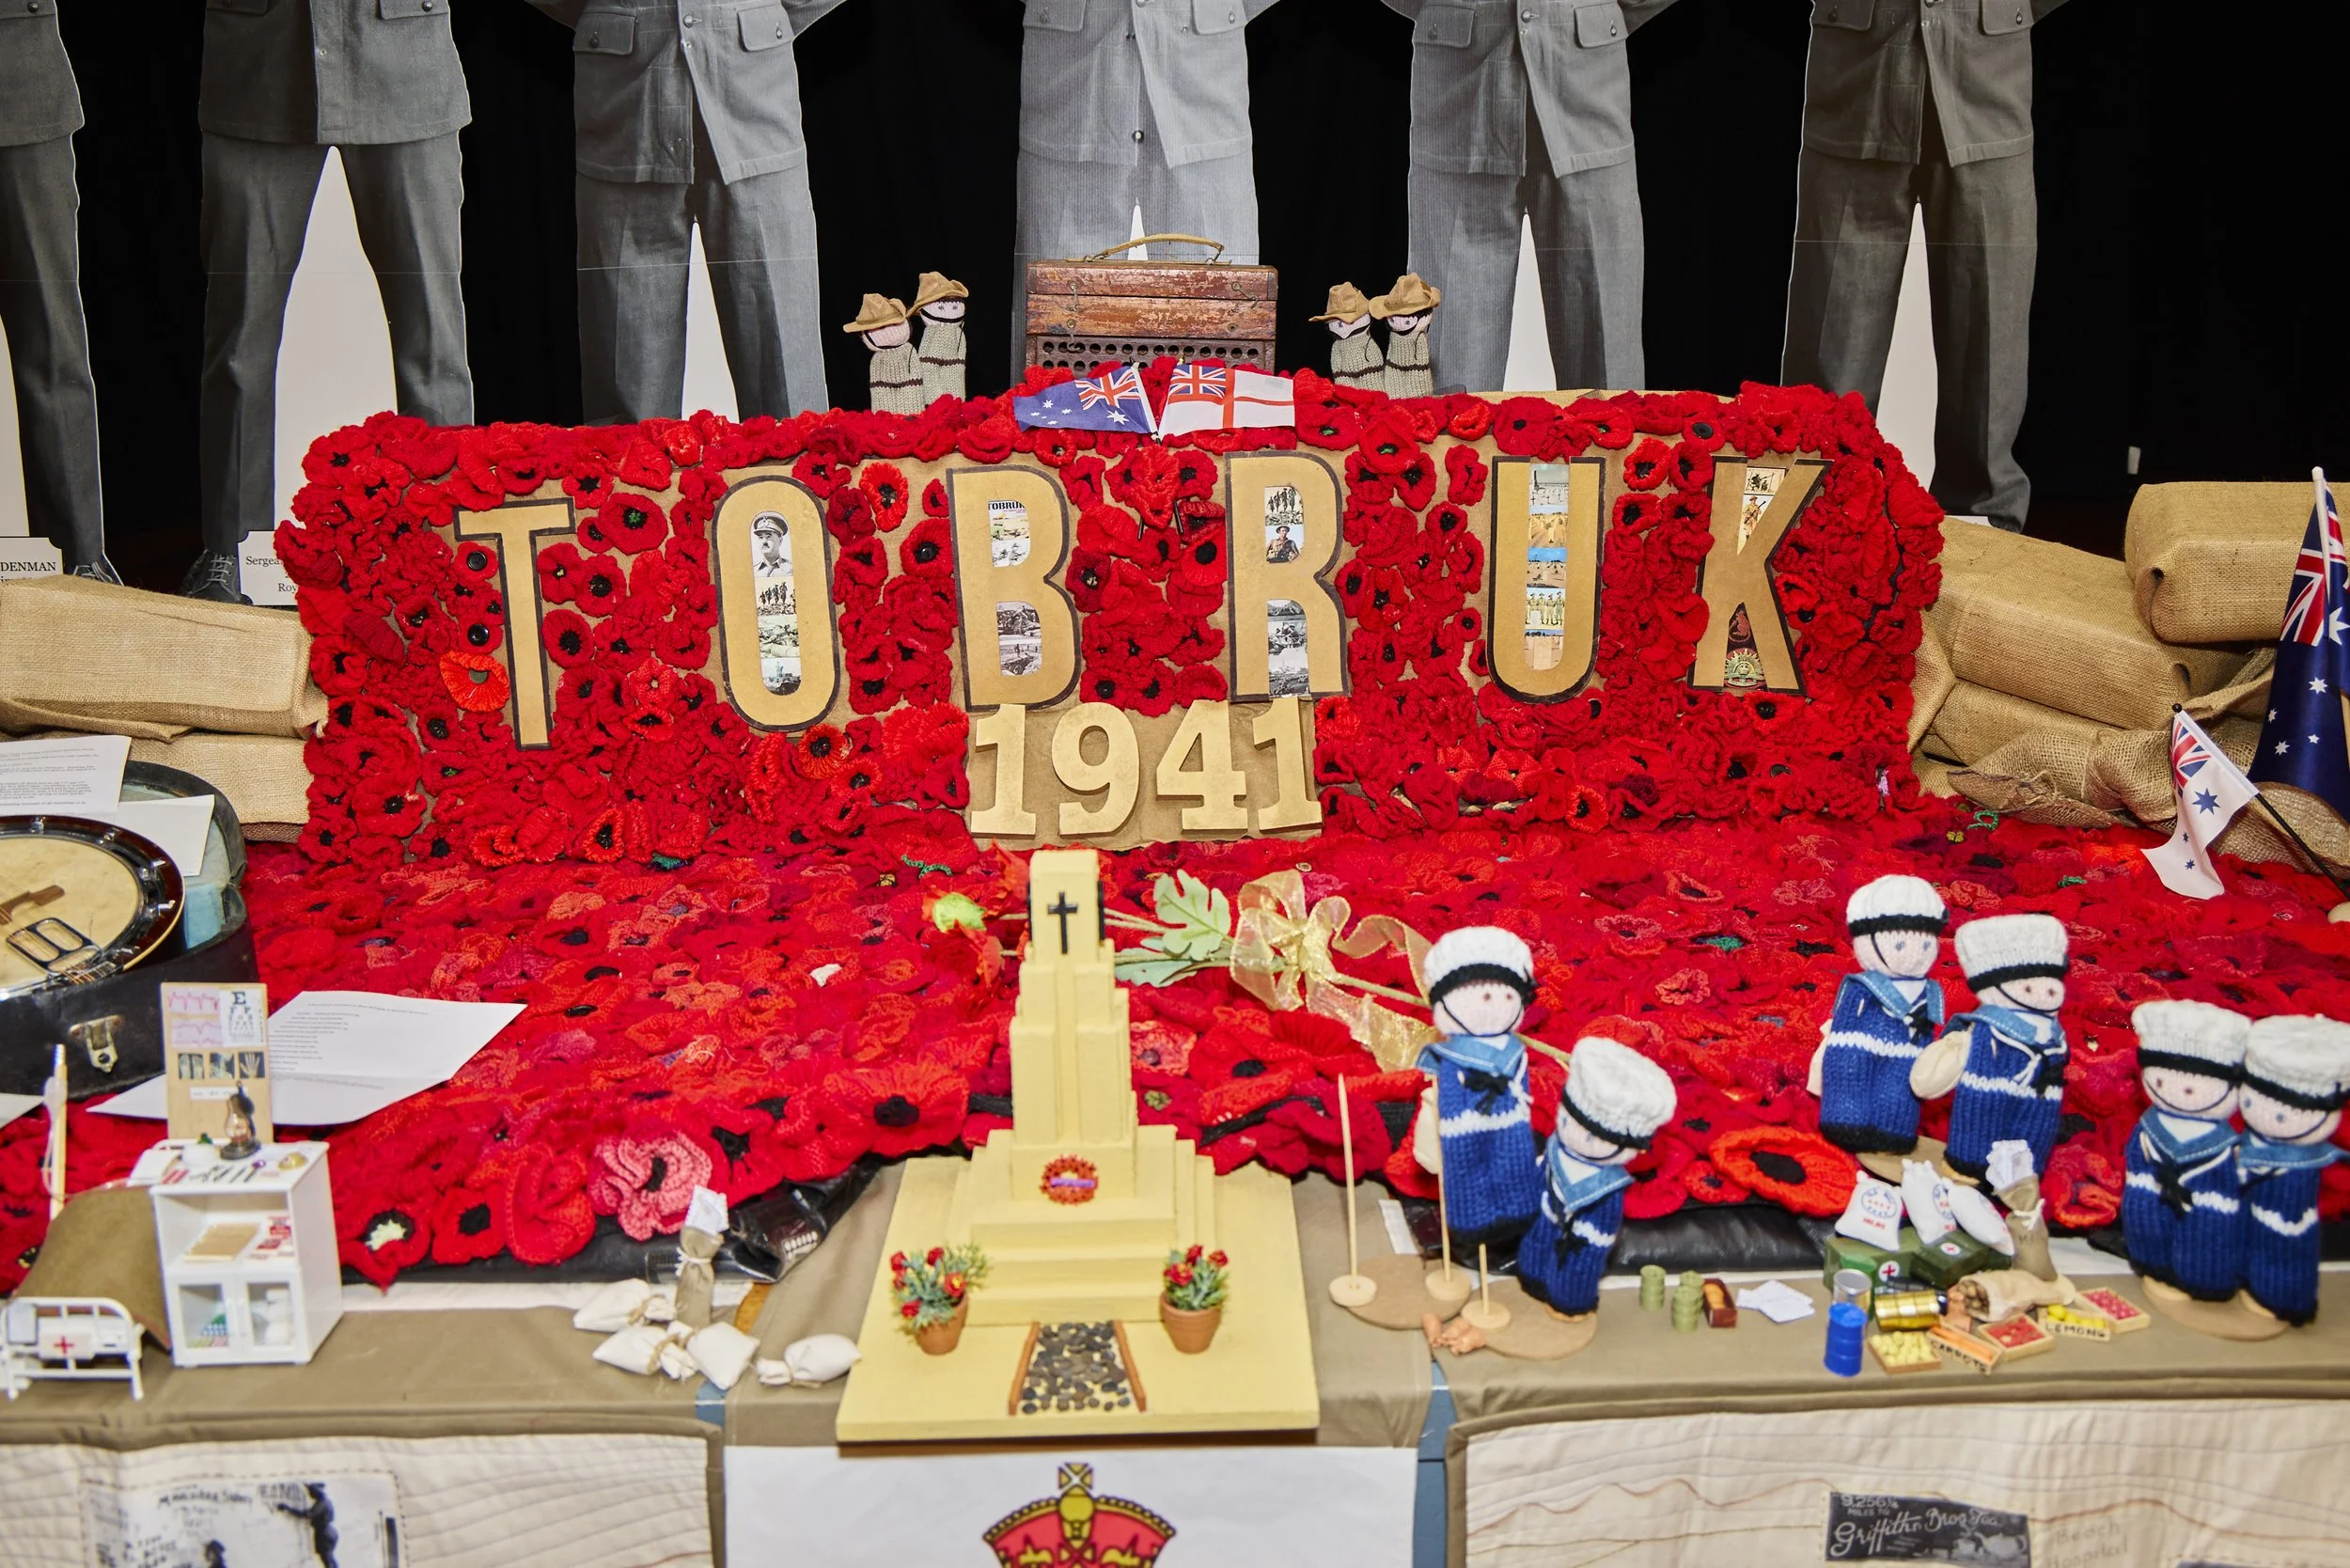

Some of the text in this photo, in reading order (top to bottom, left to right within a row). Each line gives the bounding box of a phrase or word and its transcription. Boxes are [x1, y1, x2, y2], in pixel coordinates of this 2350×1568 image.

[0, 561, 56, 572] DENMAN
[245, 556, 284, 568] Sergea
[453, 450, 1834, 750] TOBRUK
[969, 697, 1324, 837] 1941
[2044, 1323, 2107, 1340] LEMONS
